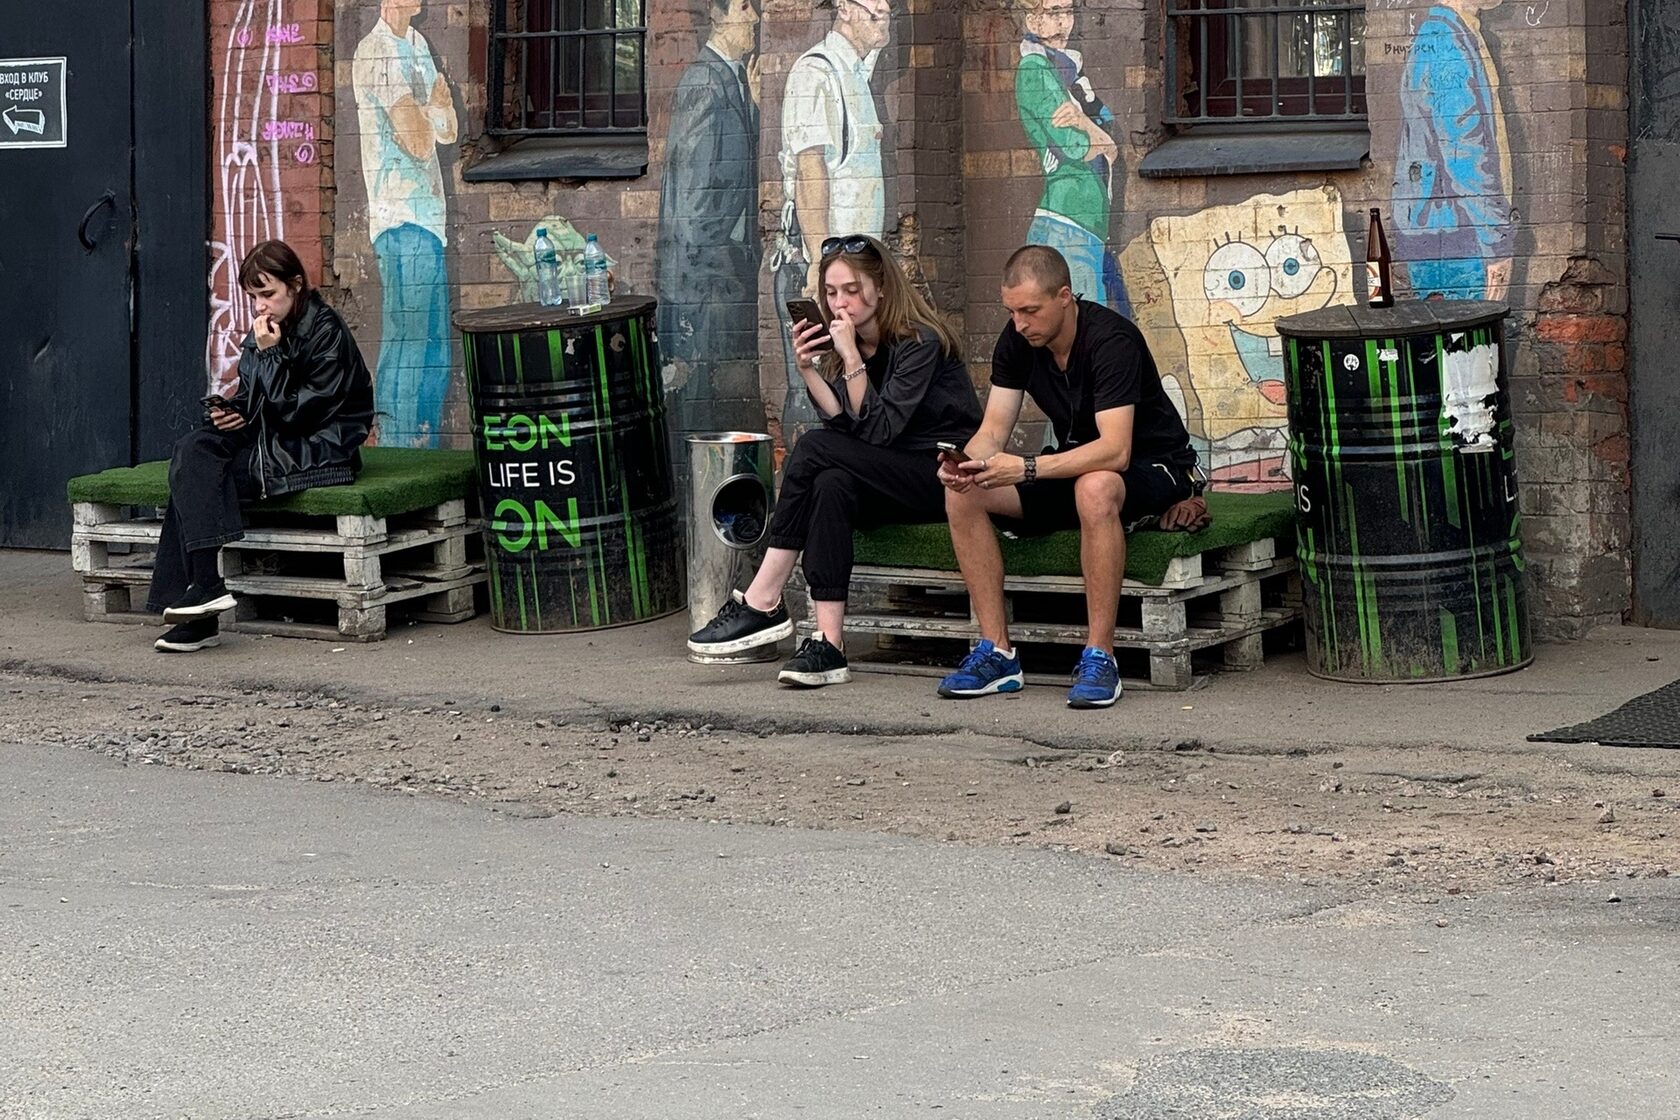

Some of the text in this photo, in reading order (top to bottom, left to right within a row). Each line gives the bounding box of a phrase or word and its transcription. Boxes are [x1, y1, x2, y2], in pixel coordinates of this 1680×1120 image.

[0, 71, 49, 86] ВХОД В КЛУБ
[5, 88, 43, 101] «СЕРДЦЕ»
[488, 460, 576, 487] LIFE IS
[491, 497, 581, 552] ON
